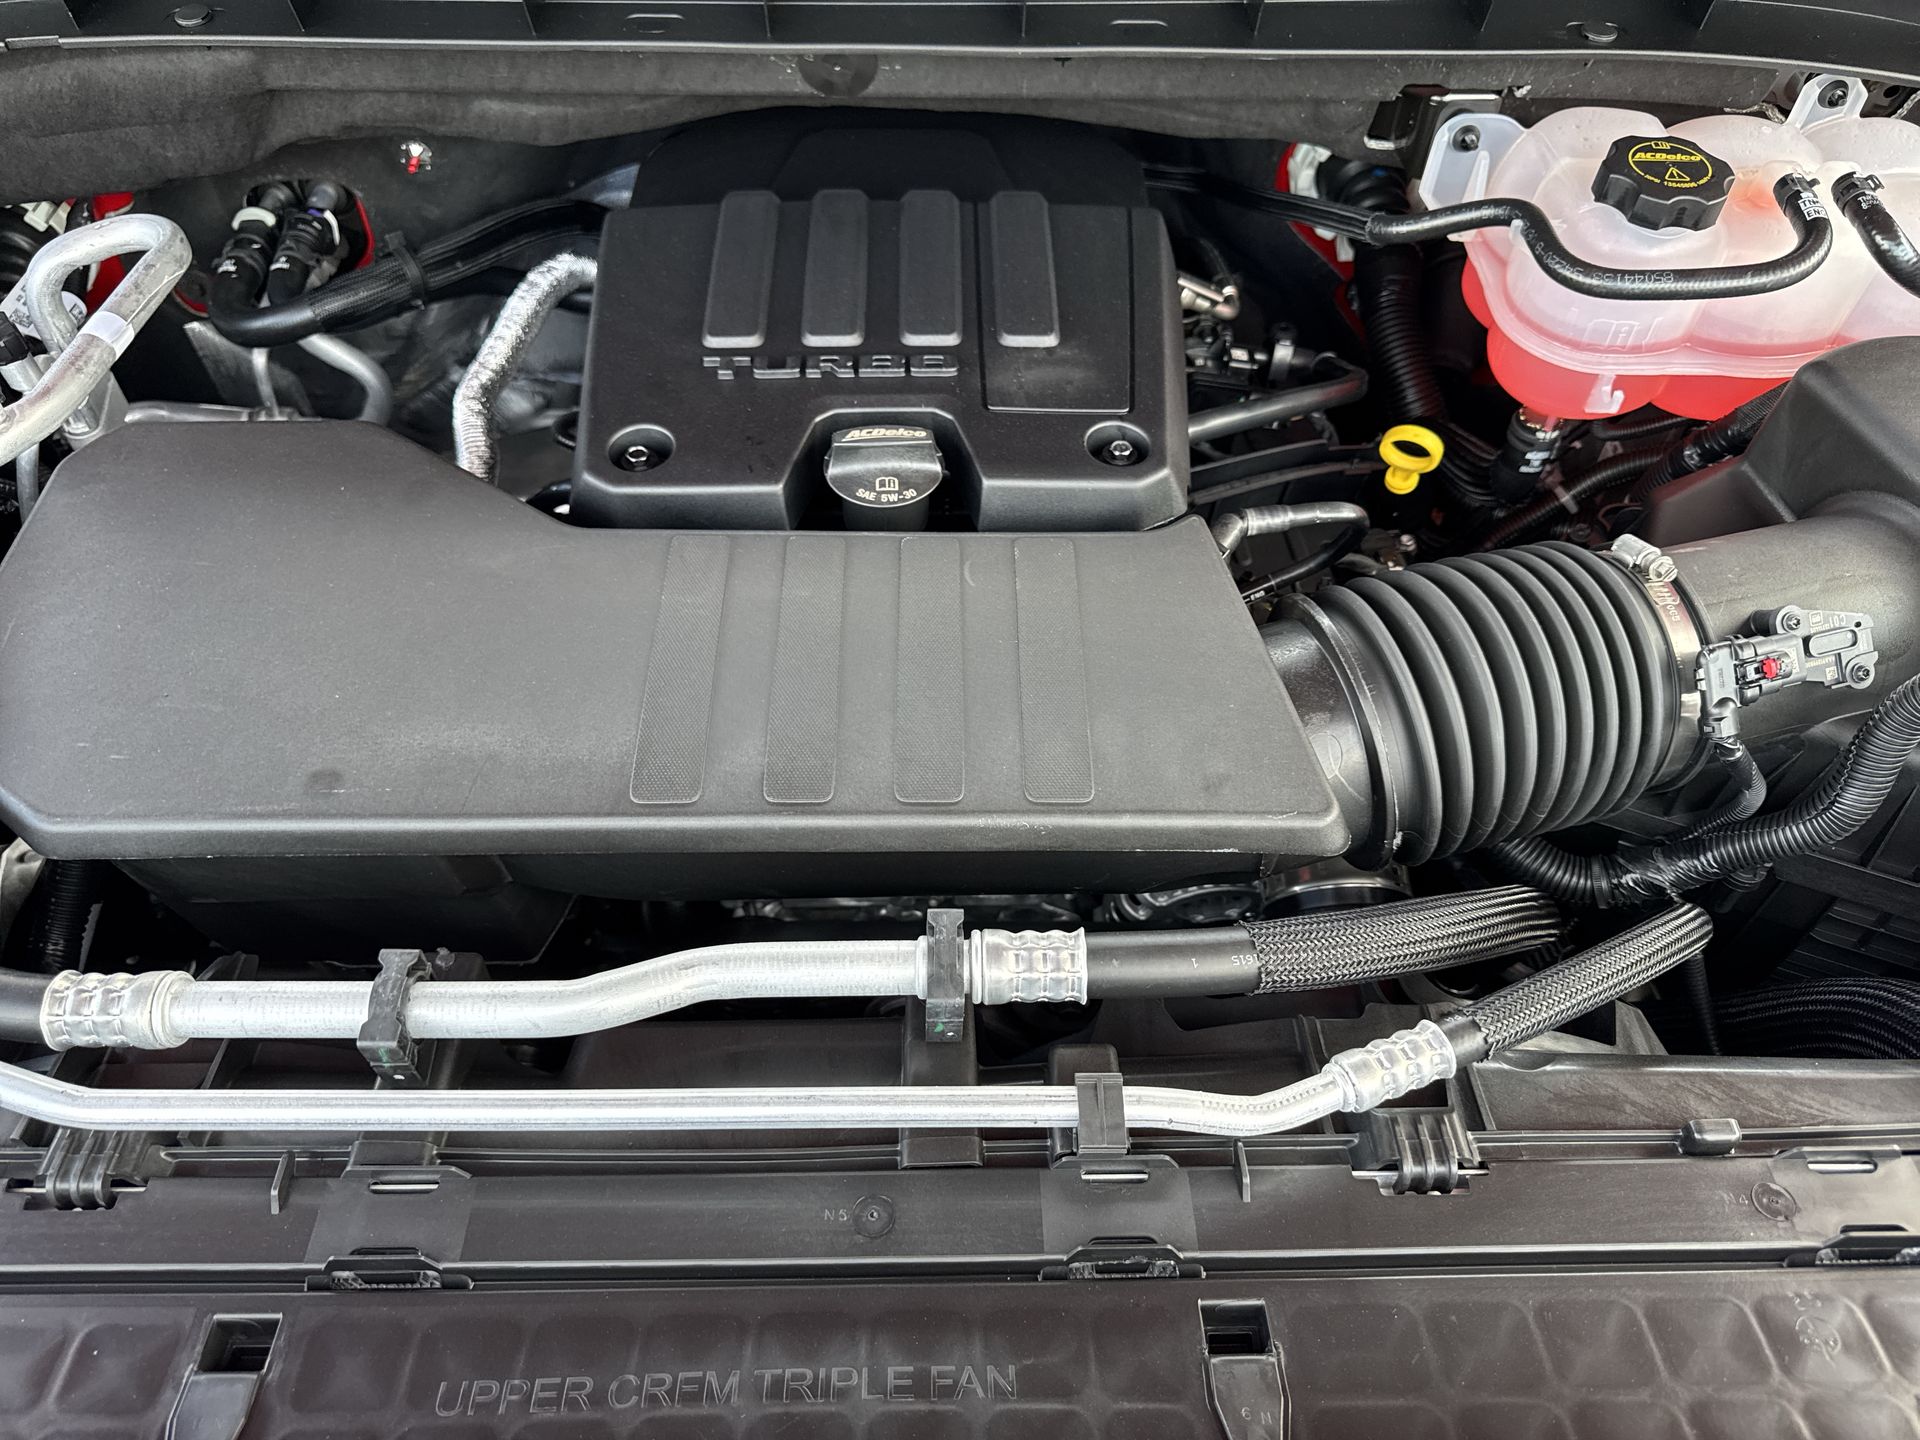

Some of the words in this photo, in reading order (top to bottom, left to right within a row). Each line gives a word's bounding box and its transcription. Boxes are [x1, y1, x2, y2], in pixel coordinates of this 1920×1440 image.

[1632, 152, 1700, 161] ACDelco
[702, 355, 958, 380] TURBO
[843, 428, 927, 440] ACDelco
[856, 488, 877, 501] SAE
[881, 488, 917, 503] 5W-30
[434, 1376, 594, 1417] UPPER
[607, 1369, 740, 1409] CRFM
[754, 1366, 914, 1404] TRIPLE
[930, 1364, 1017, 1401] FAN
